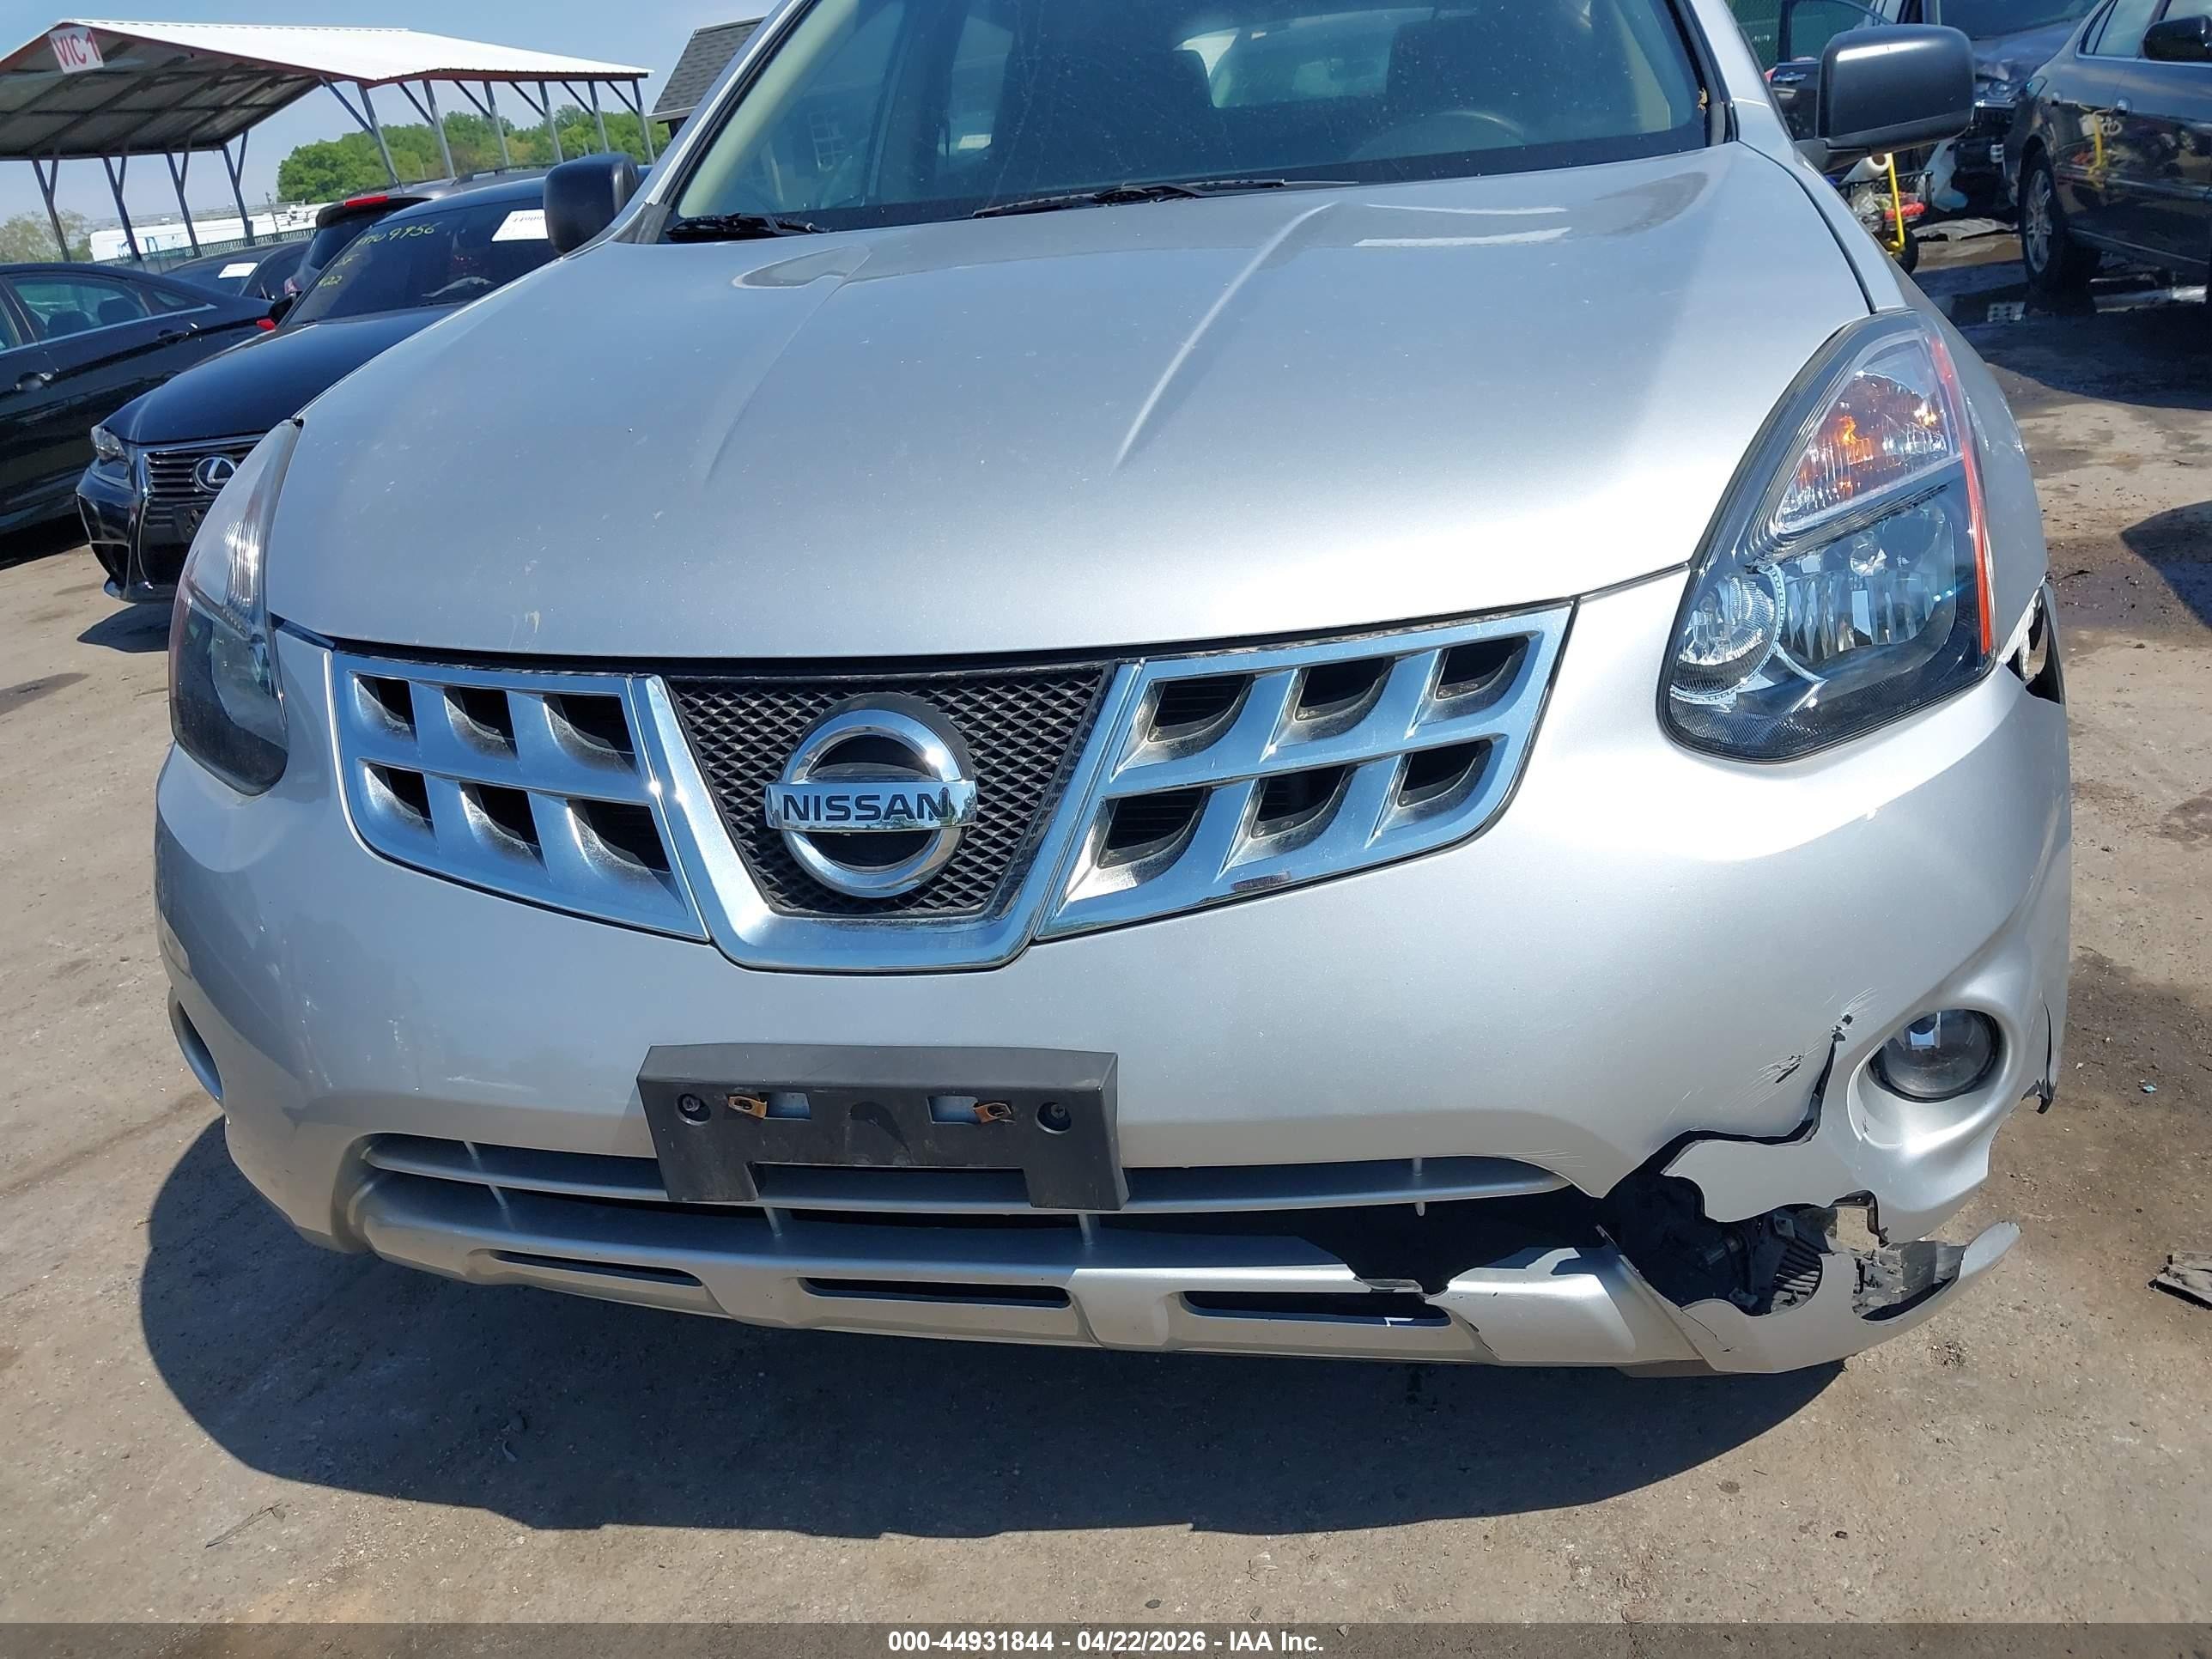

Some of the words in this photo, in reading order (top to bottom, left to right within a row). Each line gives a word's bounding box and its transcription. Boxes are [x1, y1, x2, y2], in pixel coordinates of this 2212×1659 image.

[52, 33, 87, 66] VIC
[86, 32, 100, 62] 1
[783, 793, 949, 821] NISSAN
